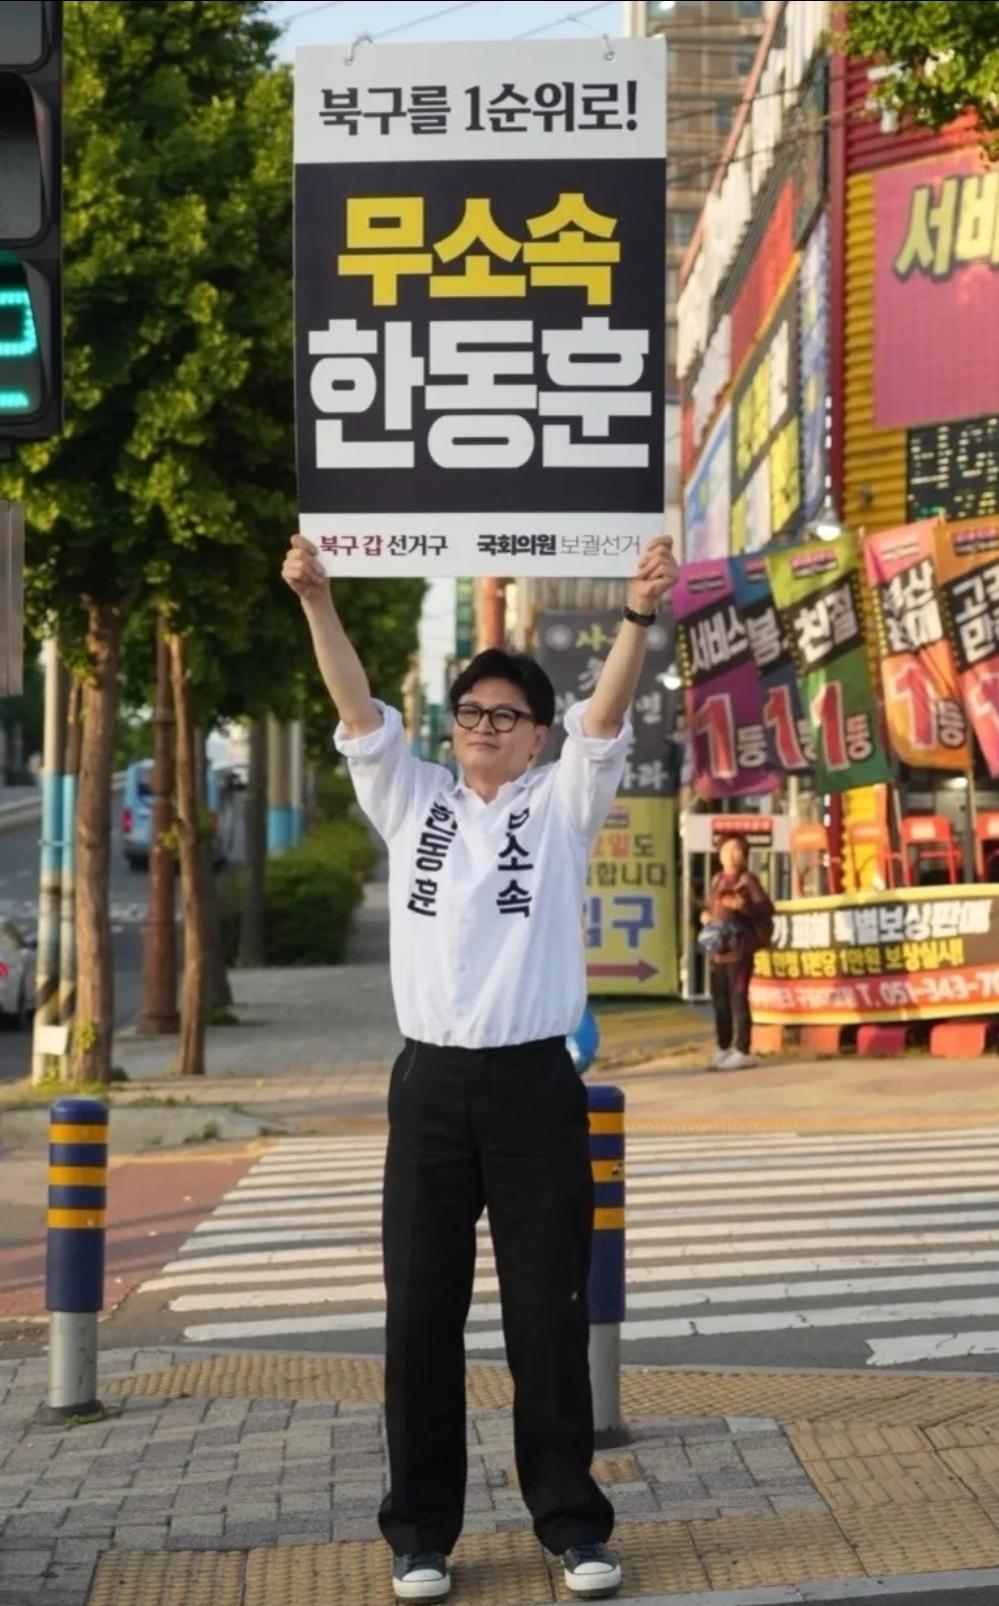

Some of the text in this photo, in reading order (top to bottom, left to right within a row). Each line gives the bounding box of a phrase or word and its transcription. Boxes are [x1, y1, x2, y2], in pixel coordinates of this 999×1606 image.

[320, 80, 638, 135] 북구를 1순위로!
[338, 192, 620, 306] 무소속
[308, 317, 652, 469] 한동훈
[320, 535, 448, 557] 북구 갑 선거구
[477, 534, 640, 557] 국회의원 보궐선거
[689, 604, 749, 674] 서비스
[695, 692, 767, 780] 1등
[810, 681, 872, 773] 1등
